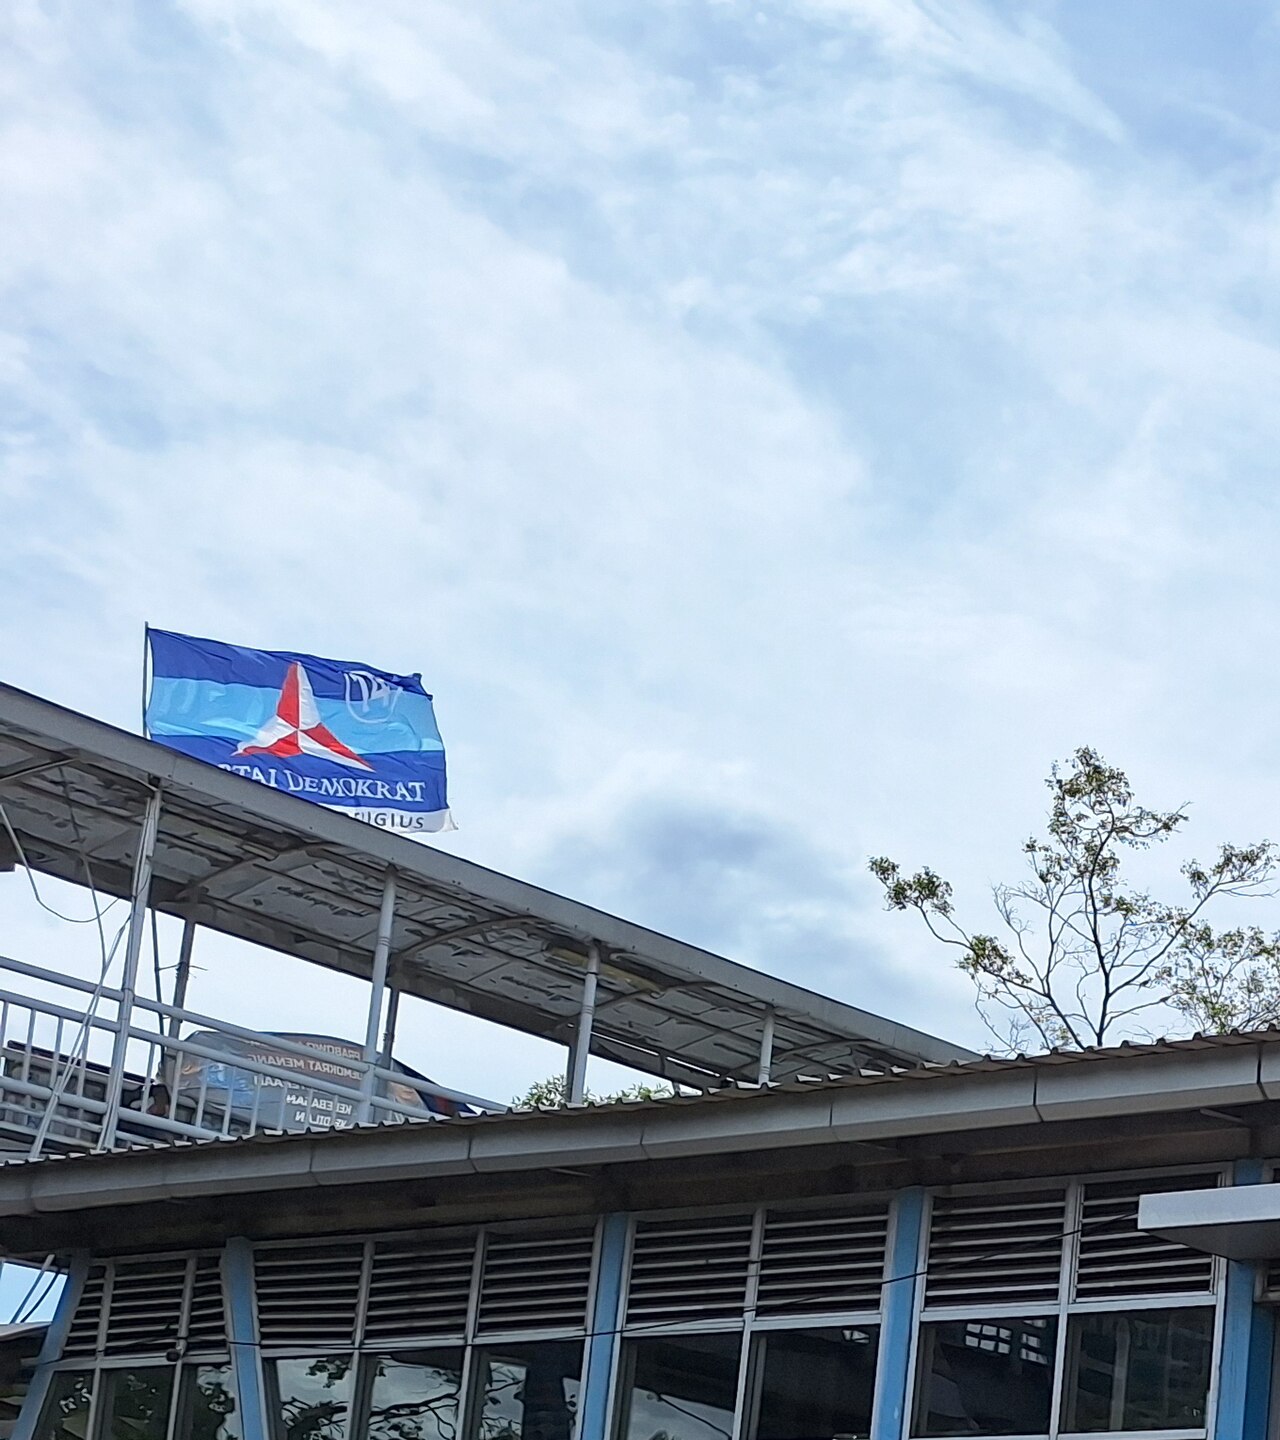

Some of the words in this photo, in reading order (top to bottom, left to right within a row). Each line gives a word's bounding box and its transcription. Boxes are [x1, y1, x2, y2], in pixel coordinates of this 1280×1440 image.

[218, 764, 278, 788] TAI
[283, 769, 425, 801] DEMOKRAT
[354, 811, 424, 829] IGIUS
